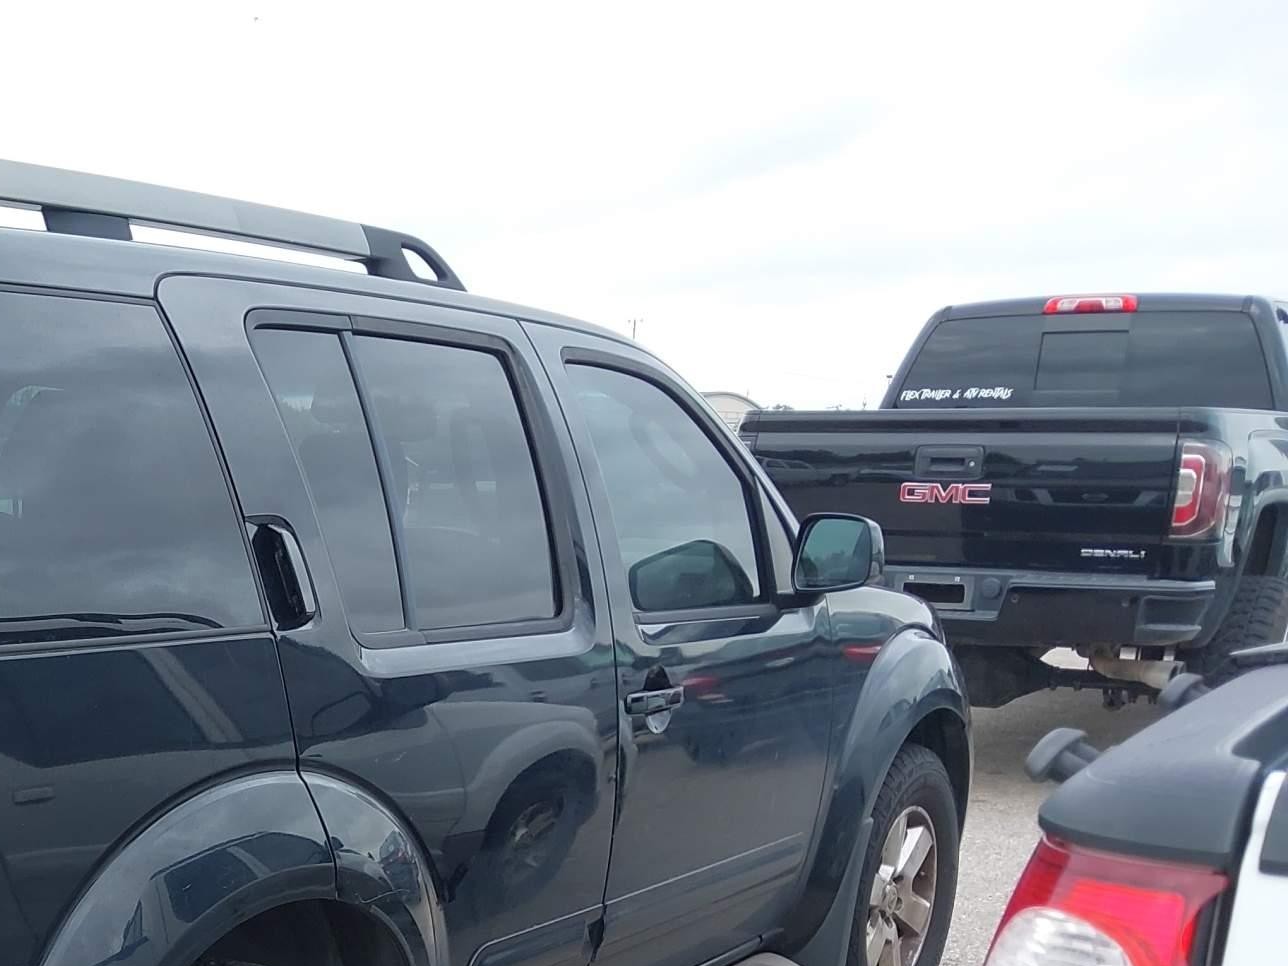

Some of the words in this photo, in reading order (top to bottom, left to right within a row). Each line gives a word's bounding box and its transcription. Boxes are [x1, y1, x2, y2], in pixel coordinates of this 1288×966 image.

[900, 389, 921, 401] FLEX
[920, 388, 952, 401] TRAILER
[952, 388, 962, 399] &
[963, 387, 980, 399] ATV
[978, 386, 1014, 400] RENTALS
[900, 482, 992, 505] GMC
[1079, 548, 1146, 559] DENALI
